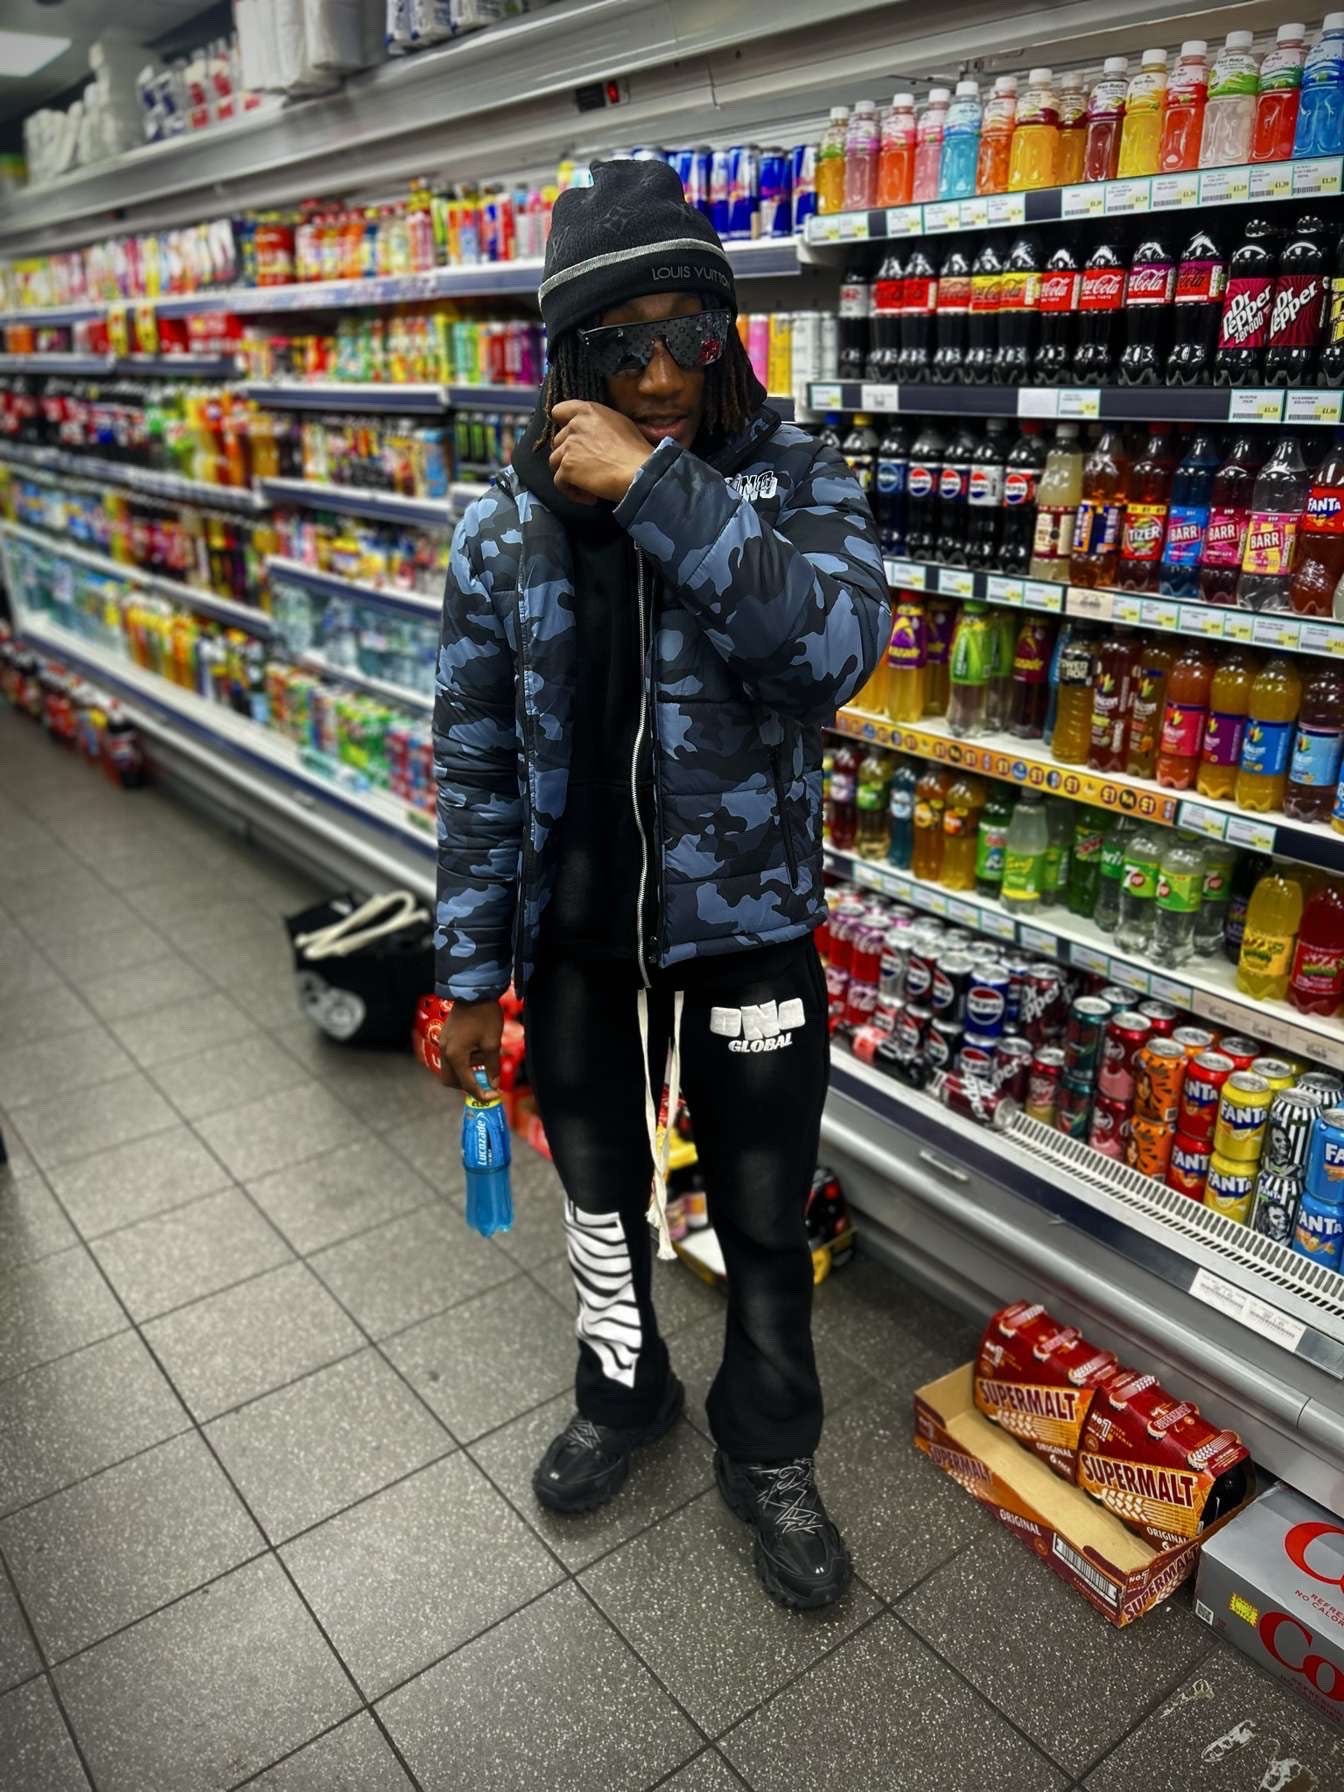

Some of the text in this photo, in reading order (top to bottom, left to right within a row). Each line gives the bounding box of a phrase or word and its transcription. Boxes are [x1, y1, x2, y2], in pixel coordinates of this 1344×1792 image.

[651, 265, 730, 288] LOUIS VUITTO
[1231, 290, 1251, 316] Dr
[1269, 280, 1318, 339] Pepper
[1277, 286, 1295, 311] Dr
[1223, 285, 1272, 342] Pepper
[1307, 496, 1342, 512] FANTA
[1128, 526, 1161, 542] TIZER
[1170, 525, 1198, 542] BARR
[1208, 524, 1236, 542] BARR
[1250, 532, 1280, 549] BARR
[970, 1000, 1002, 1010] PEPSI
[728, 1032, 793, 1052] GLOBAL
[1184, 1081, 1218, 1101] NTA
[476, 1119, 488, 1166] Lucozade
[1172, 1146, 1208, 1171] FANT
[1208, 1167, 1253, 1192] FANTA
[1301, 1208, 1343, 1234] ANTA
[976, 1377, 1080, 1423] SUPERMALT
[1036, 1442, 1074, 1459] ORIGINAL
[1080, 1452, 1198, 1508] SUPERMALT
[1000, 1508, 1043, 1536] ORIGINAL
[1146, 1526, 1189, 1545] ORIGINA
[1122, 1542, 1200, 1624] SUPERMALT
[1294, 1589, 1344, 1628] NO CALOR
